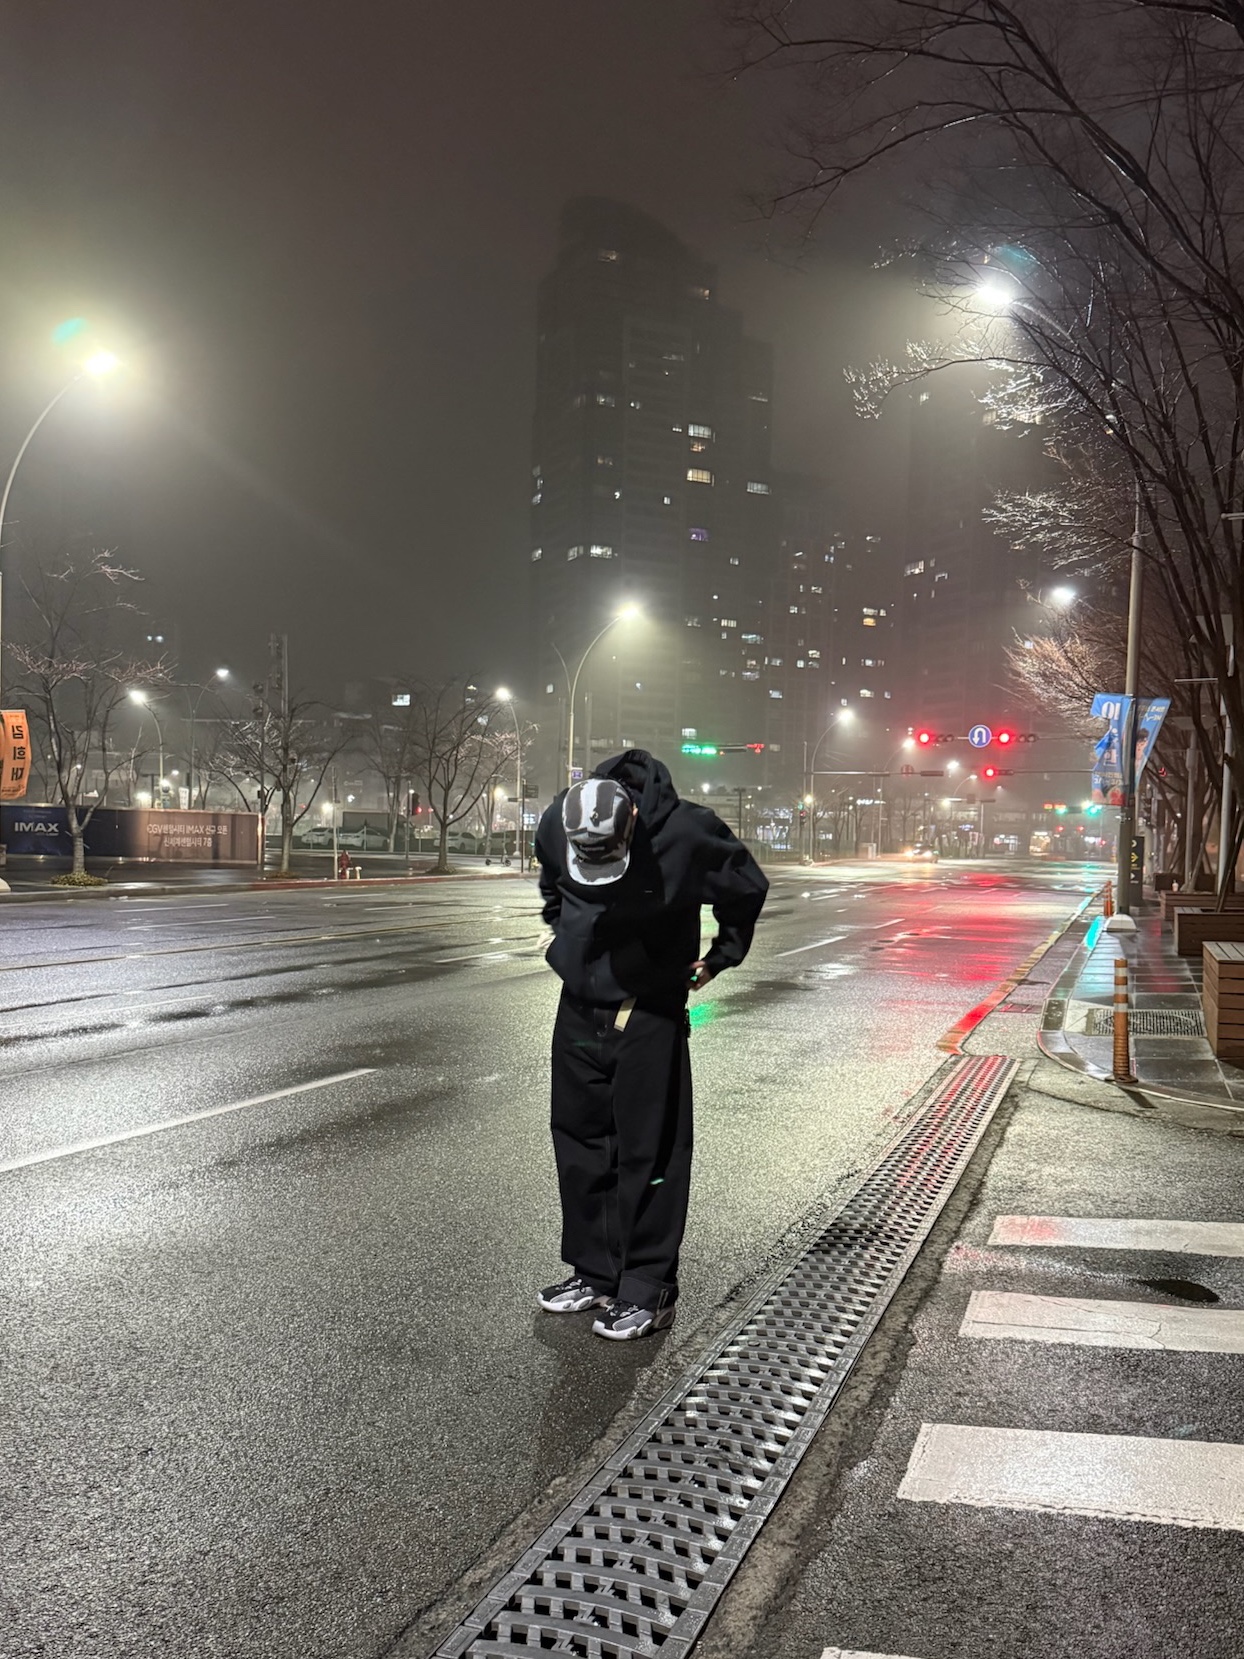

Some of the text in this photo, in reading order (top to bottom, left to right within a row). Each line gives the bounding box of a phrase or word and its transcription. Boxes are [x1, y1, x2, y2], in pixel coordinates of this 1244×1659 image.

[14, 822, 59, 833] IMAX
[186, 824, 204, 834] IMAX
[205, 825, 216, 834] 신규
[217, 825, 228, 835] 오픈
